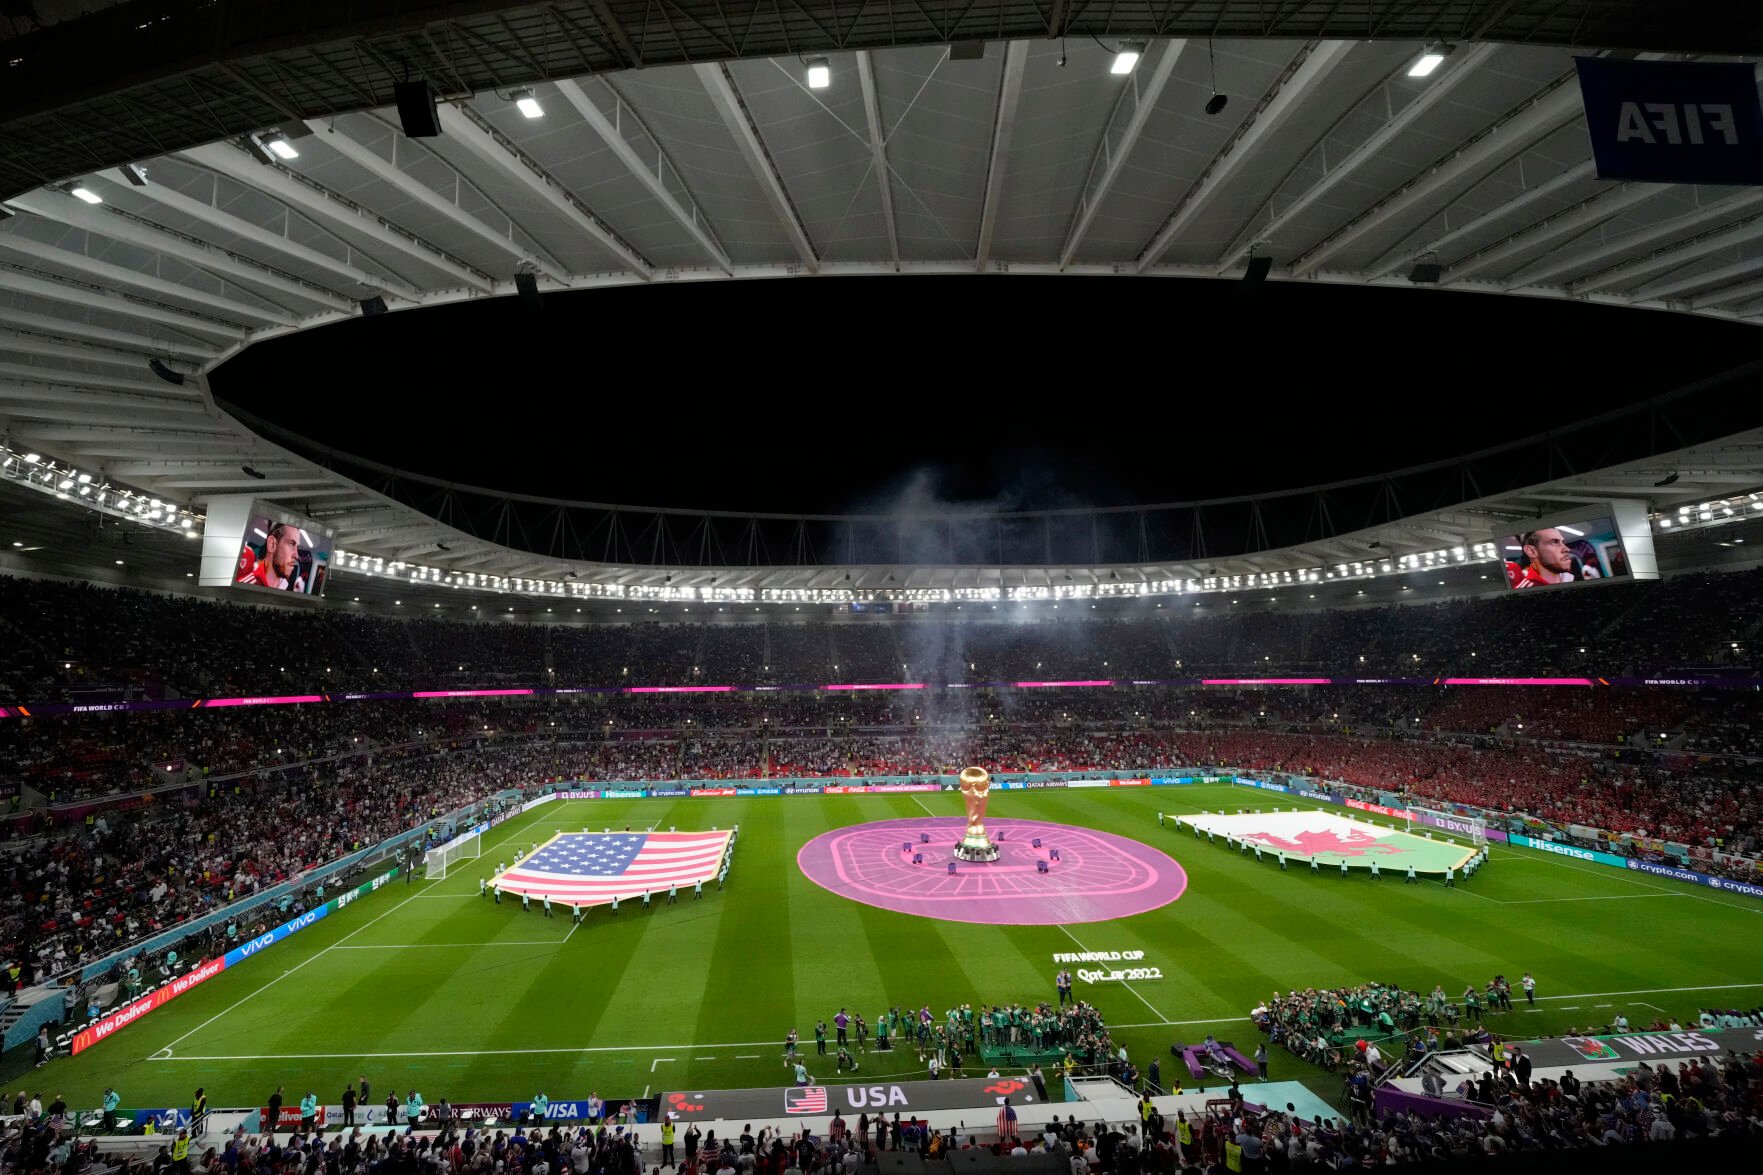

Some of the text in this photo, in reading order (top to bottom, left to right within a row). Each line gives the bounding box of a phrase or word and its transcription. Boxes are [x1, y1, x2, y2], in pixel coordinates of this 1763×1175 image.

[570, 790, 595, 799] BYJU'S
[605, 790, 642, 798] Hisense
[1528, 837, 1595, 861] Hisense
[1640, 862, 1699, 882] crypto.com
[287, 911, 315, 932] vivo
[241, 932, 274, 956] vivo
[1053, 953, 1079, 963] FIFA
[1122, 950, 1145, 960] CUP
[172, 978, 188, 994] We
[188, 962, 220, 986] Deliver
[95, 1022, 114, 1038] We
[115, 999, 153, 1027] Deliver
[1614, 1031, 1720, 1055] WALES
[847, 1085, 908, 1108] USA
[543, 1103, 579, 1118] VISA
